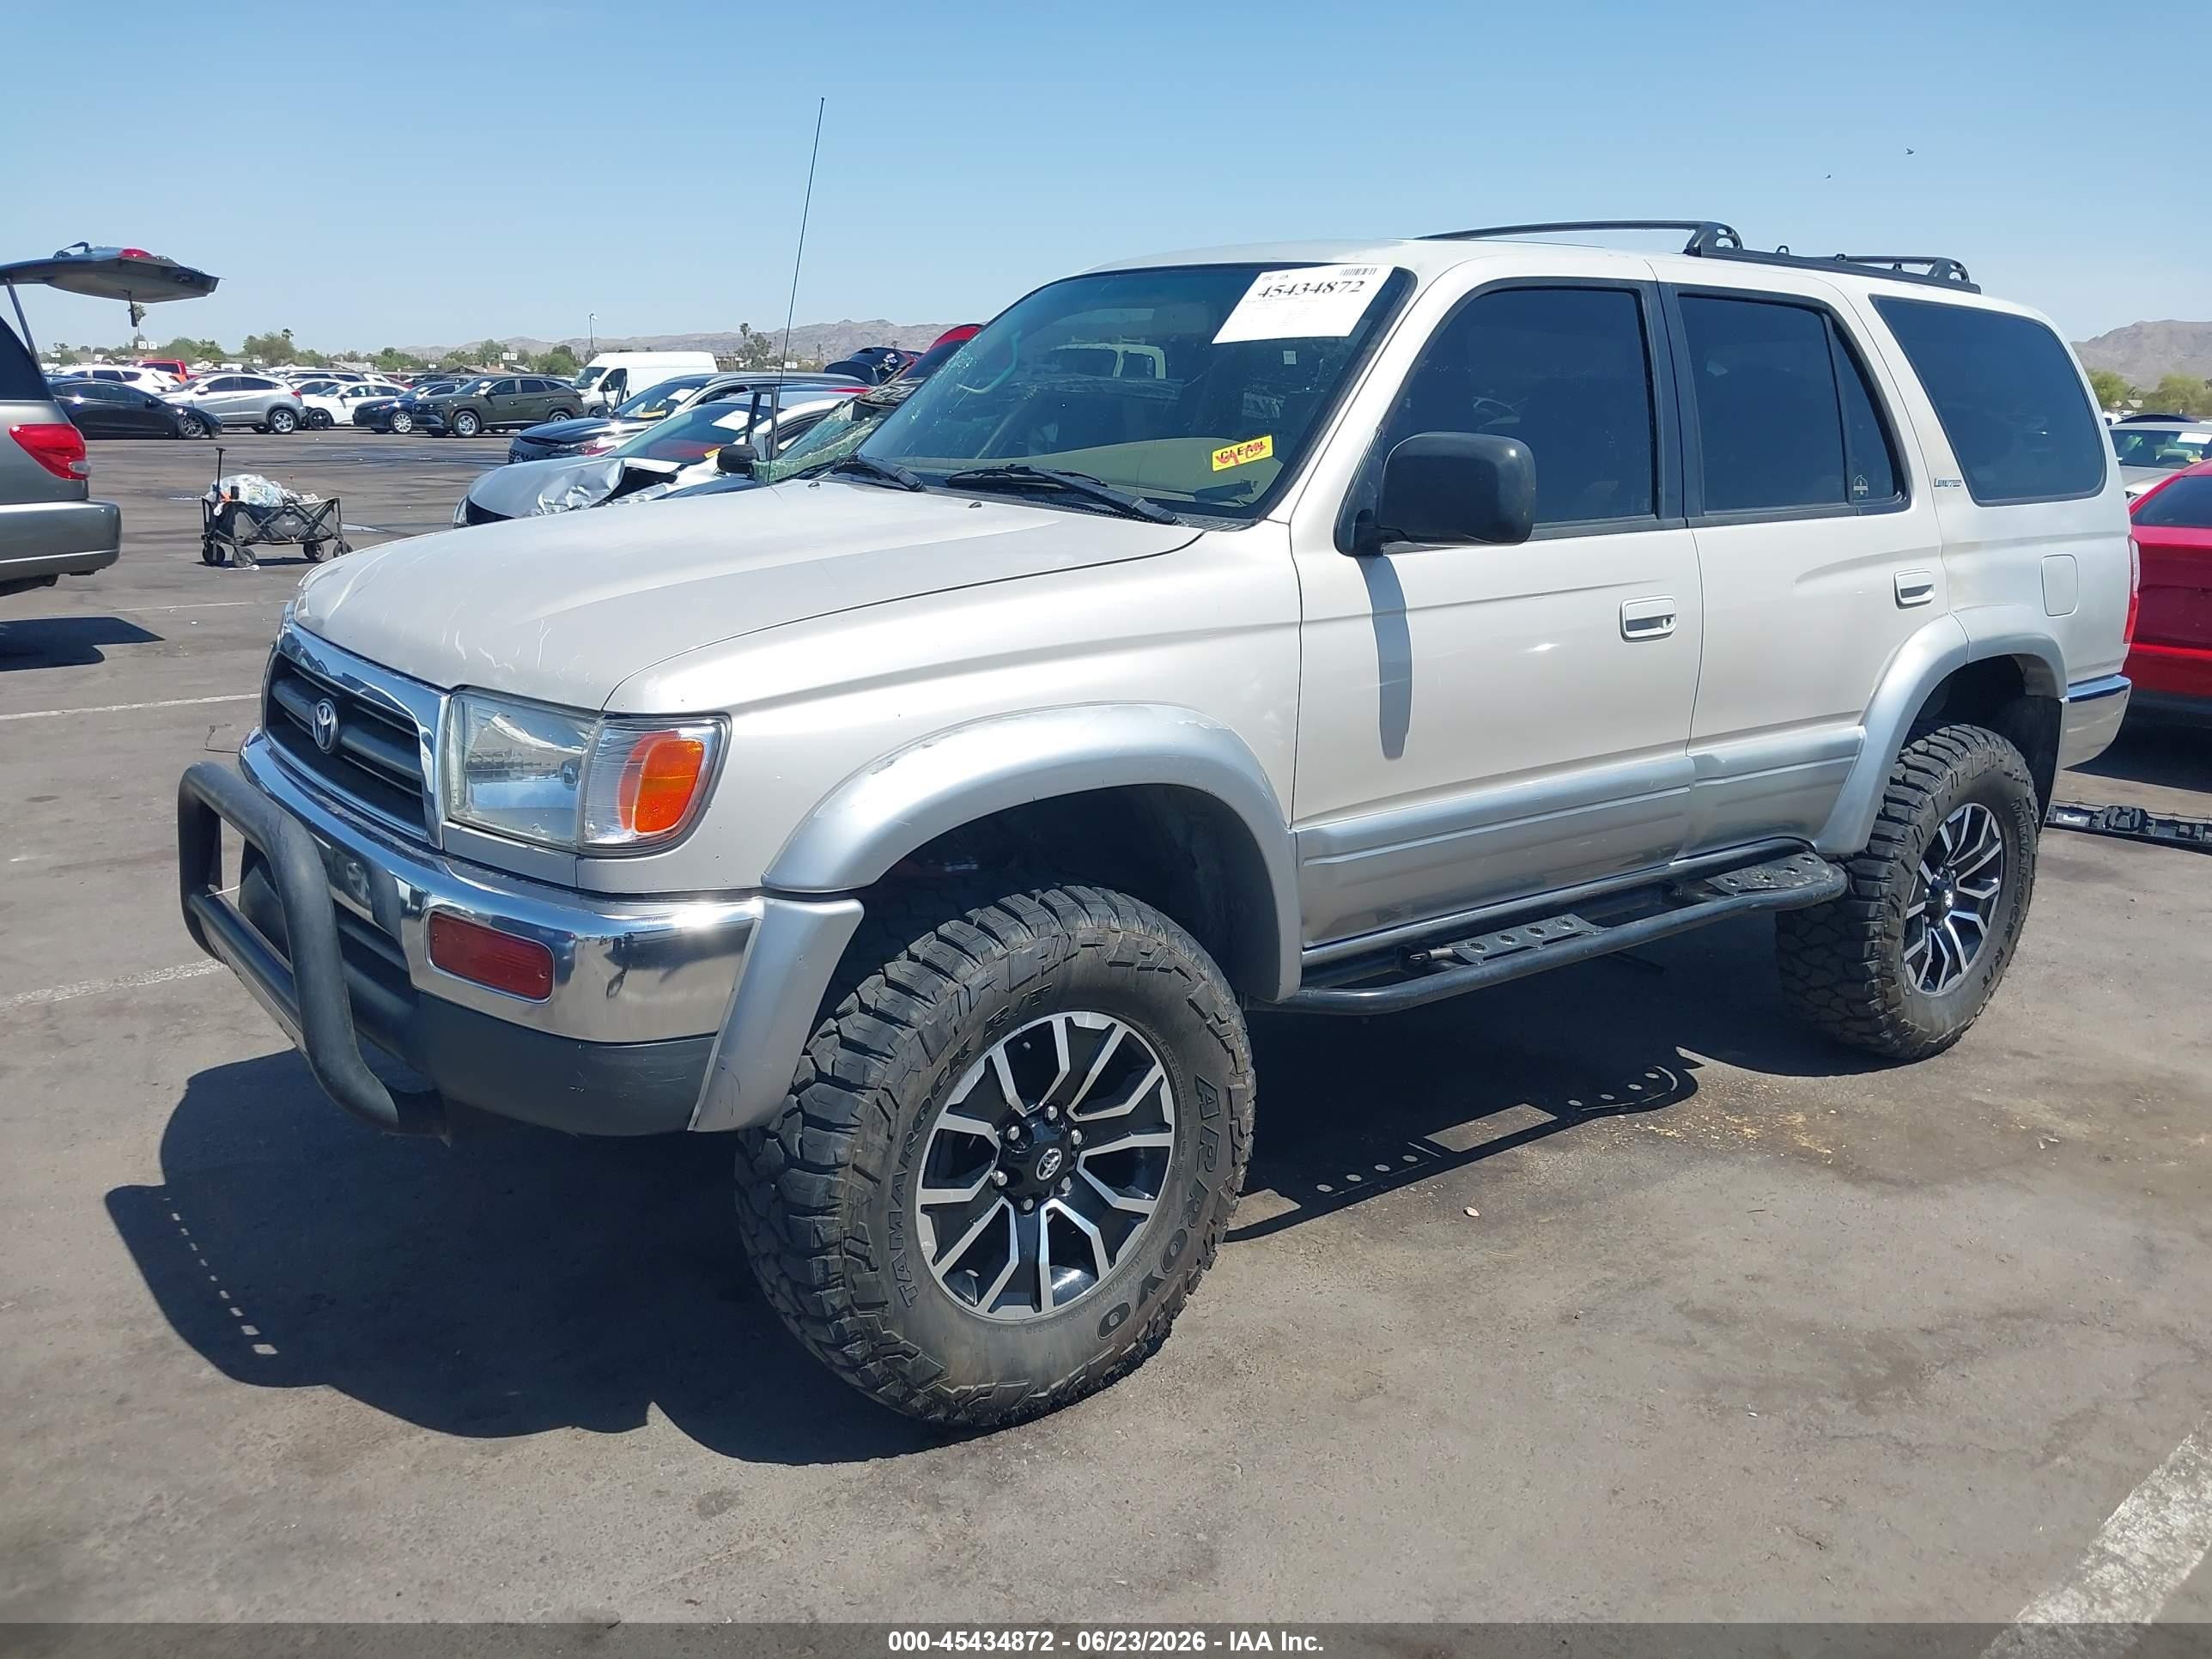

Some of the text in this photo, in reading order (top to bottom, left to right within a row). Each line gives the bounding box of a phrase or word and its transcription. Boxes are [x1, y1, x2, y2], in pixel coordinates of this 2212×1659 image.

[1257, 280, 1365, 299] 45434872
[889, 1033, 974, 1308] TAMAROCK
[1097, 1073, 1220, 1340] ARROYO
